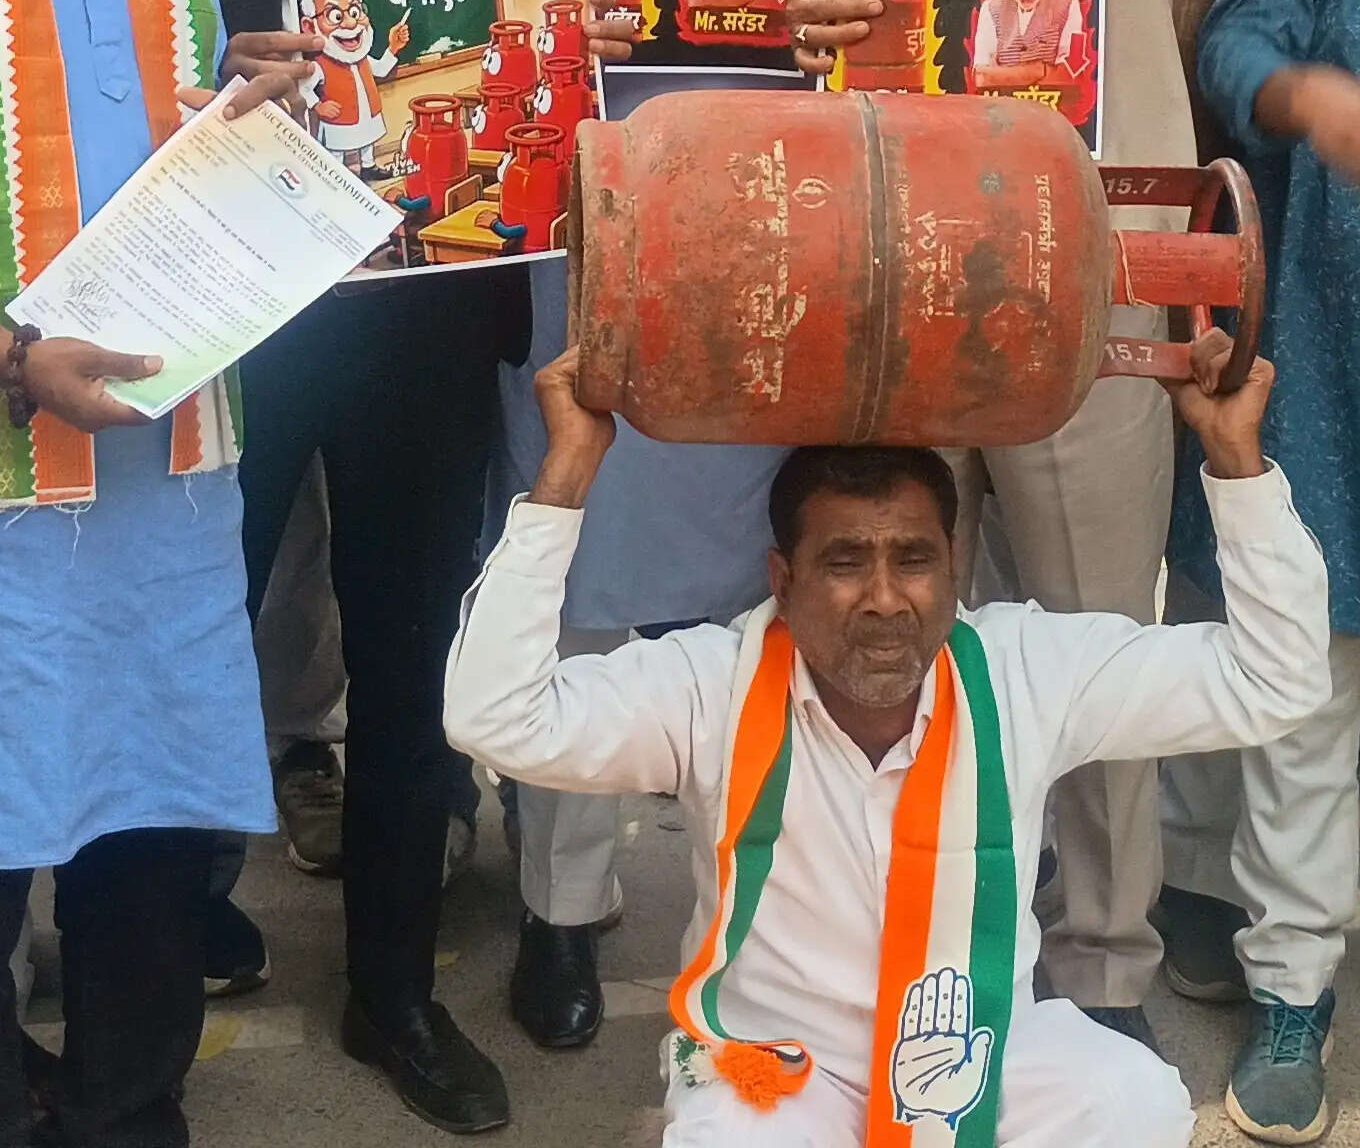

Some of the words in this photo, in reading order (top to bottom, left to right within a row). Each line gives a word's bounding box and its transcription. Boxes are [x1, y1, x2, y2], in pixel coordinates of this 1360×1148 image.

[694, 10, 718, 32] Mr.
[722, 7, 768, 33] सरेंडर
[1105, 178, 1159, 195] 15.7
[1104, 343, 1154, 363] 15.7
